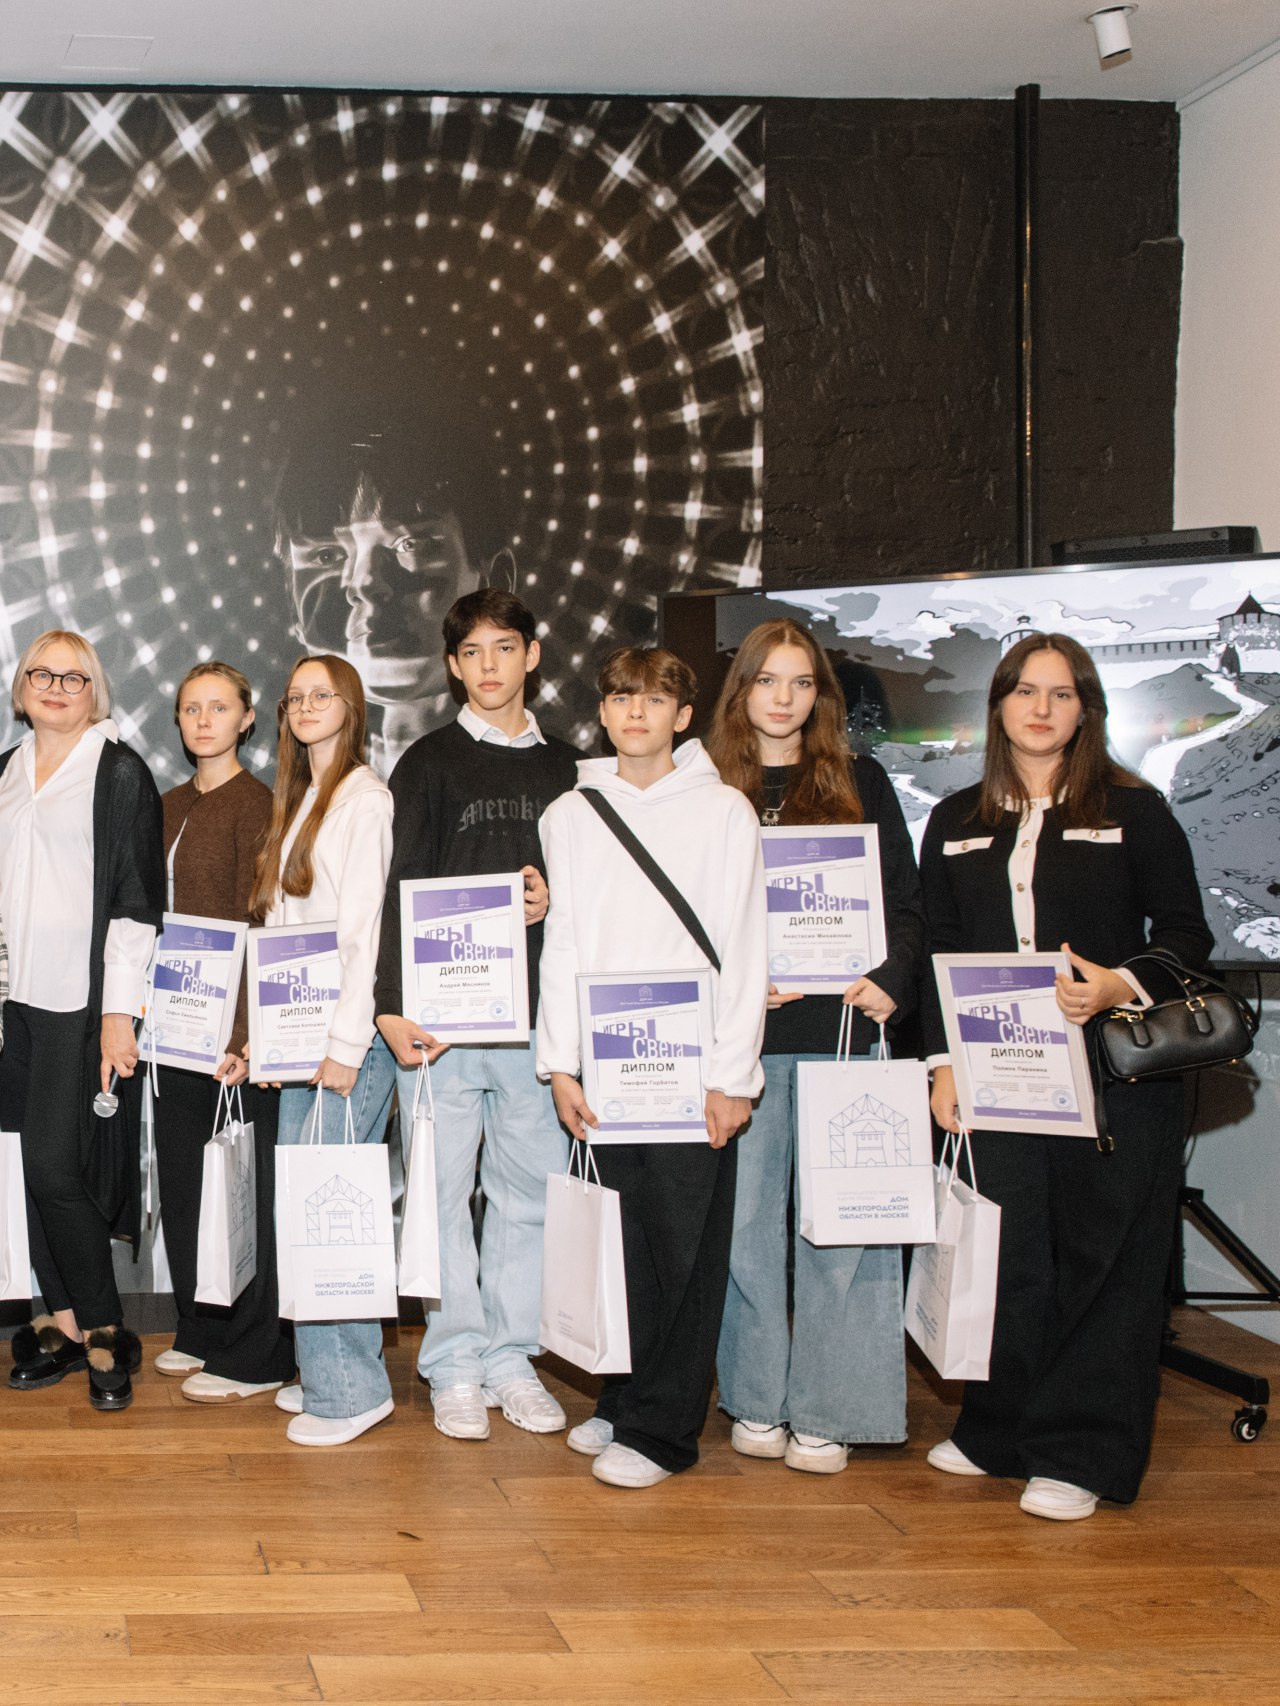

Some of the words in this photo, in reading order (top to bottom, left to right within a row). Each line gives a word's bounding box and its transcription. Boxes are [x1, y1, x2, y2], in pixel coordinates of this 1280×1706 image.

[771, 873, 824, 894] ИГРЫ
[789, 916, 843, 927] ДИПЛОМ
[424, 923, 473, 943] ИГРЫ
[164, 959, 202, 978] ИГРЫ
[439, 965, 489, 976] ДИПЛОМ
[267, 967, 308, 986] ИГРЫ
[169, 995, 208, 1009] ДИПЛОМ
[280, 1006, 323, 1018] ДИПЛОМ
[968, 1003, 1022, 1025] ИГРЫ
[603, 1018, 657, 1041] ИГРЫ
[990, 1048, 1045, 1059] ДИПЛОМ
[621, 1063, 675, 1074] ДИПЛОМ
[838, 1203, 909, 1212] НИЖЕГОРОДСКОЙ
[314, 1280, 375, 1288] НИЖЕГОРОДСКОЙ
